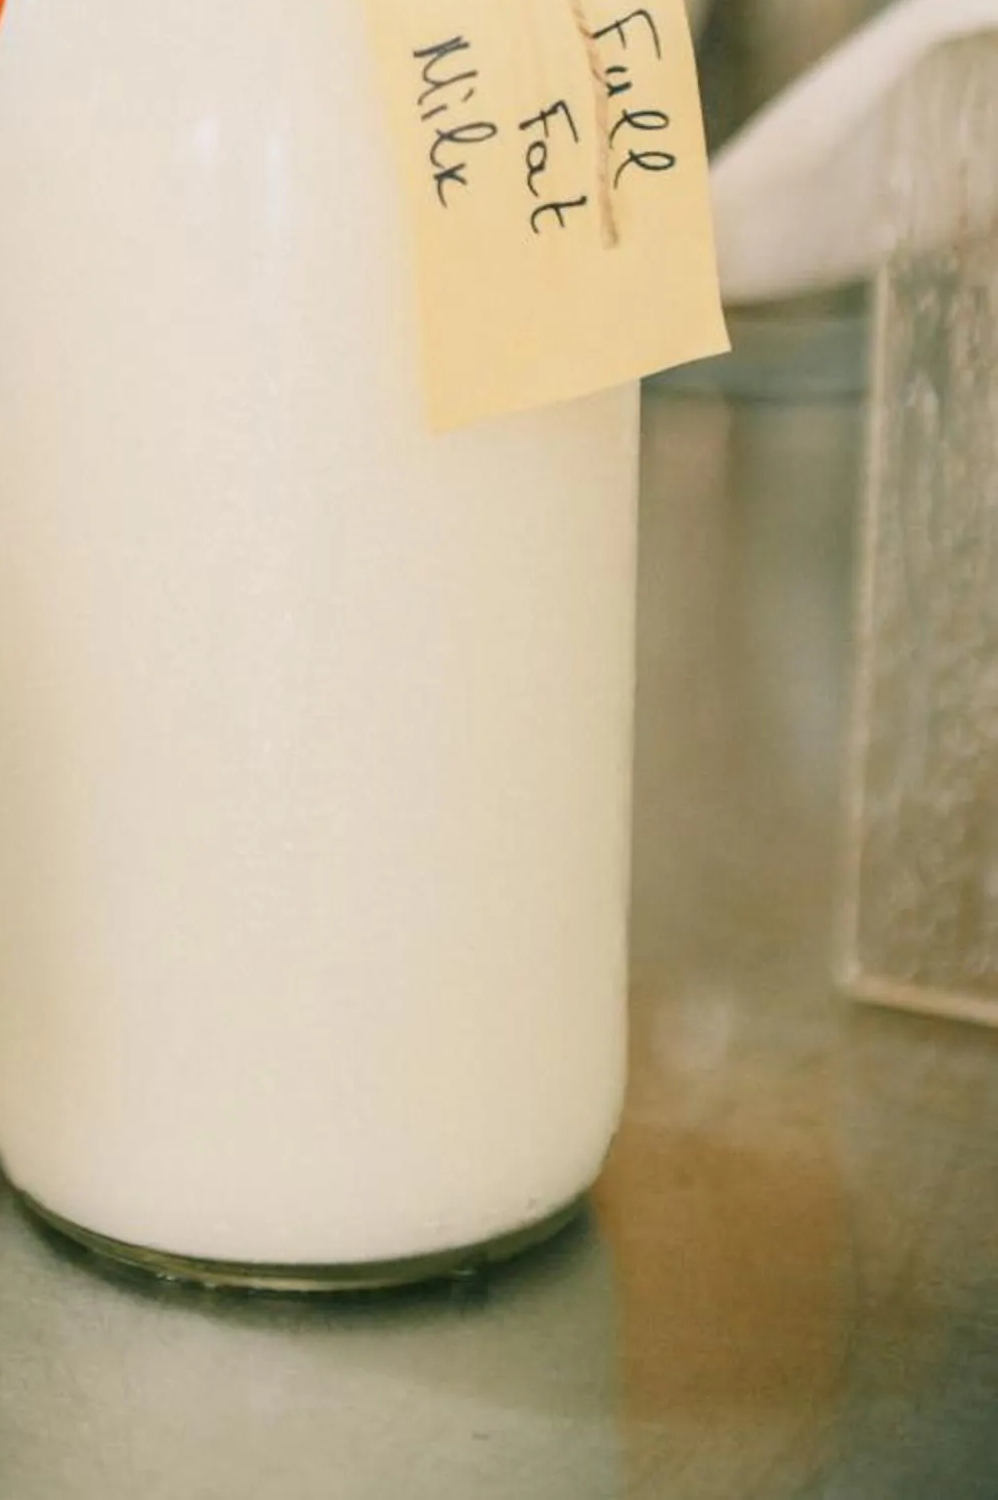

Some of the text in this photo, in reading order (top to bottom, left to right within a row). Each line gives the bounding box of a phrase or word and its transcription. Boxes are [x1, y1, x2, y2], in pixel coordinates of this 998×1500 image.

[412, 35, 498, 209] Milk
[518, 99, 588, 234] Fat
[591, 8, 676, 190] Full
